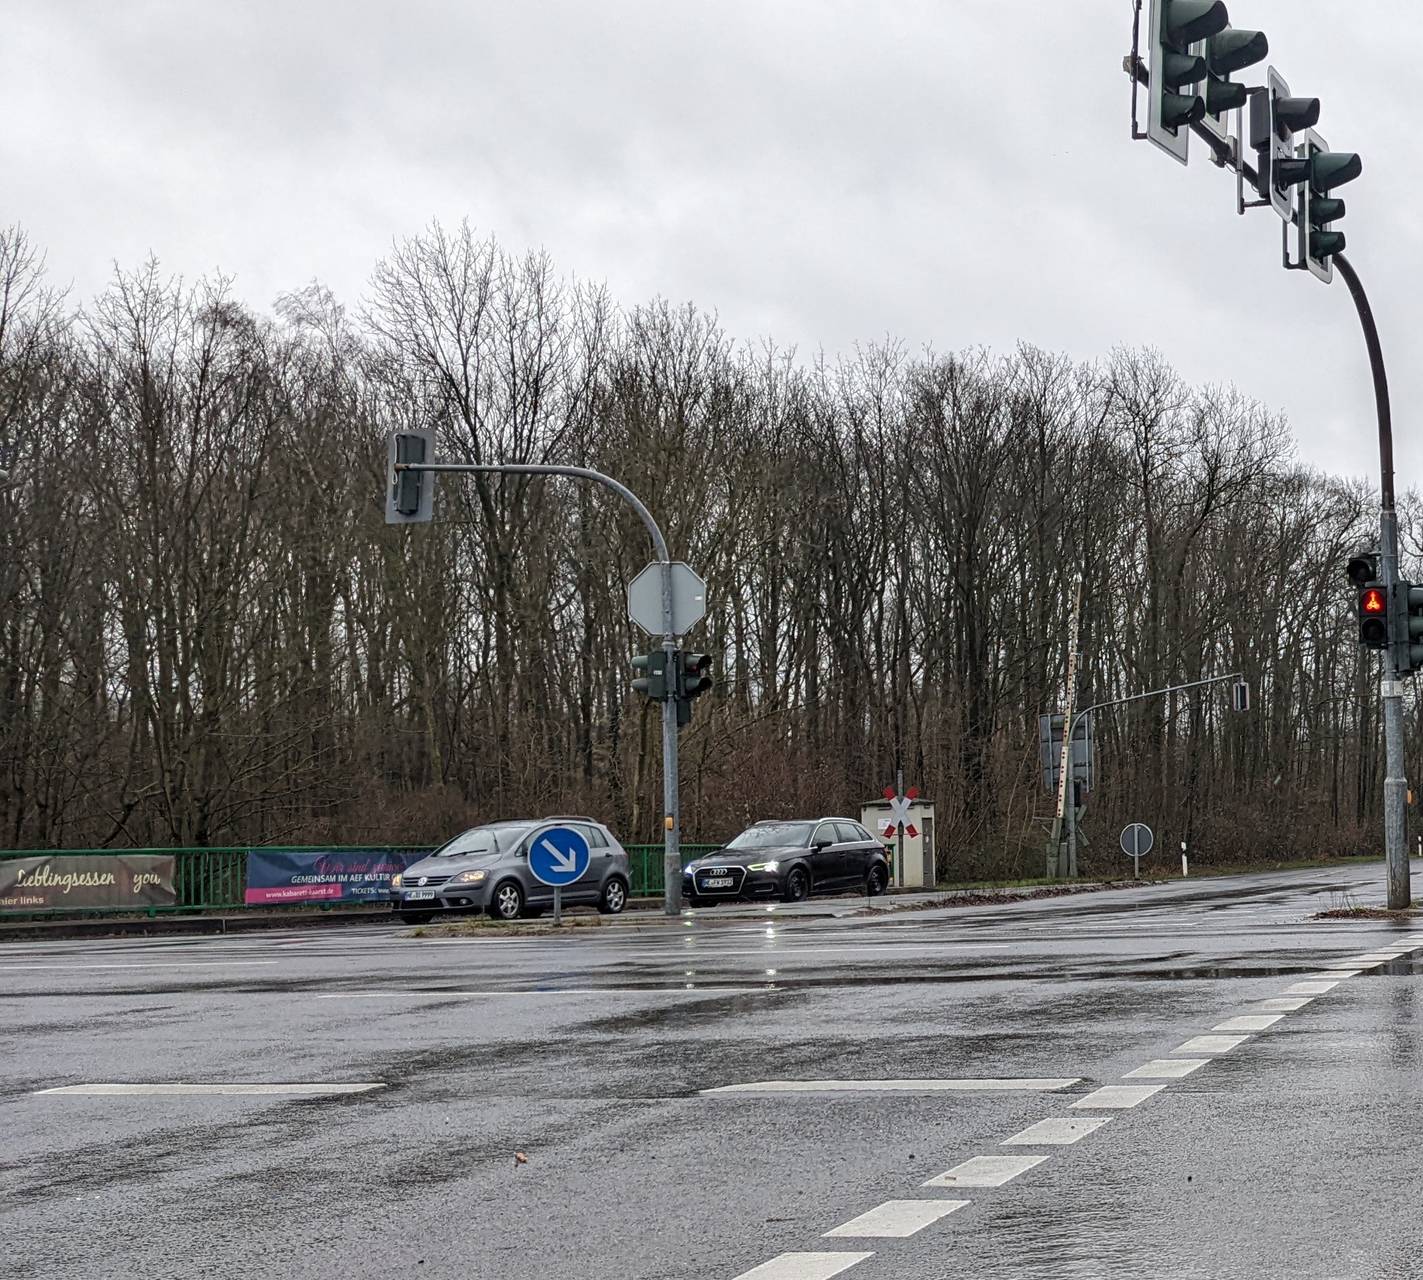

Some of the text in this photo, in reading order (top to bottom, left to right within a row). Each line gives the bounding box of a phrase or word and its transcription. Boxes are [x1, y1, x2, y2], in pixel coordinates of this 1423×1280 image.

[14, 864, 161, 894] Lieblingsessen you
[290, 874, 336, 884] GEMEINSAM
[337, 874, 349, 883] IM
[20, 895, 45, 905] links
